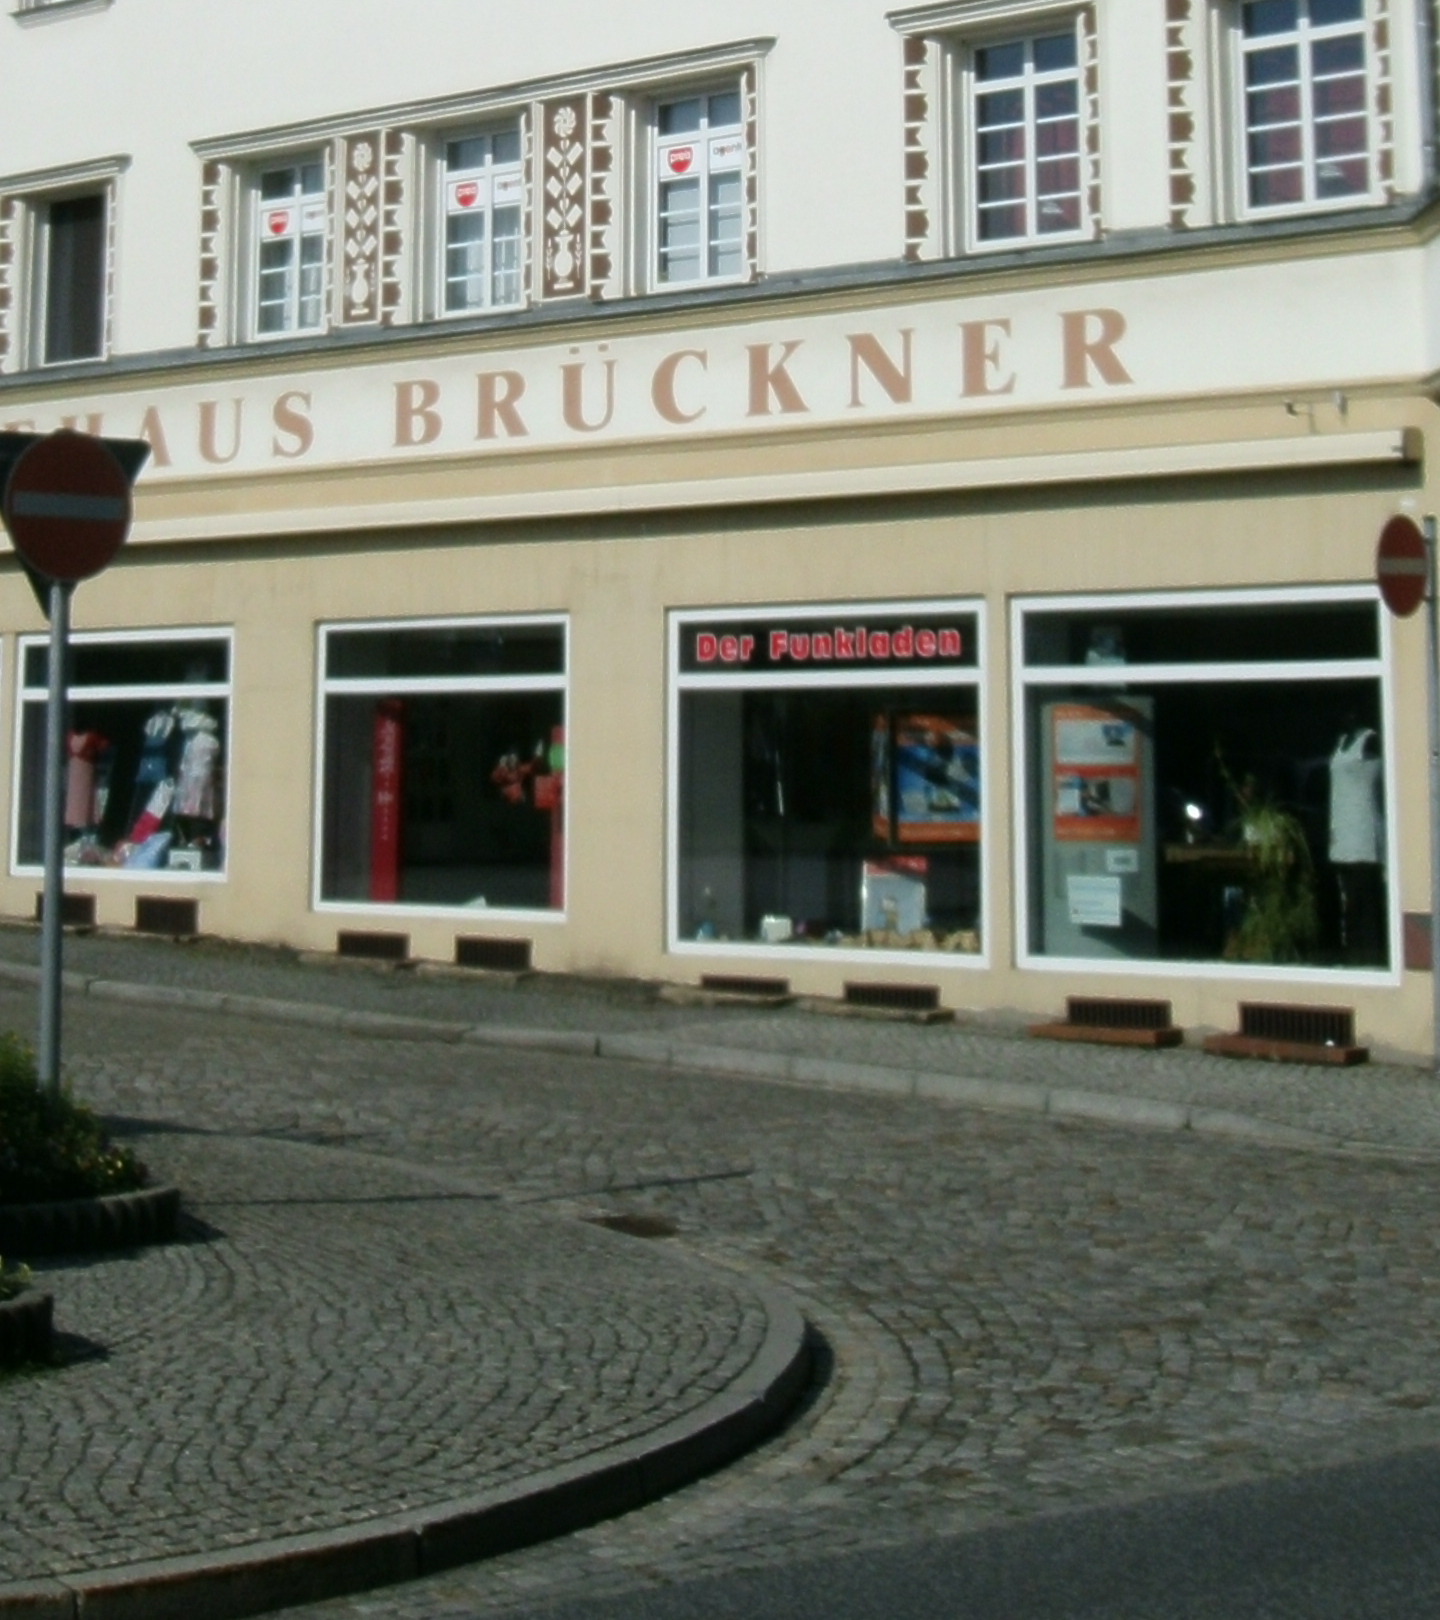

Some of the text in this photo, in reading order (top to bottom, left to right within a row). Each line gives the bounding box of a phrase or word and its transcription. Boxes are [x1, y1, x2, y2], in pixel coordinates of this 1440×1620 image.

[392, 306, 1135, 448] BRÜCKNER
[696, 624, 962, 663] Der Funkladen
